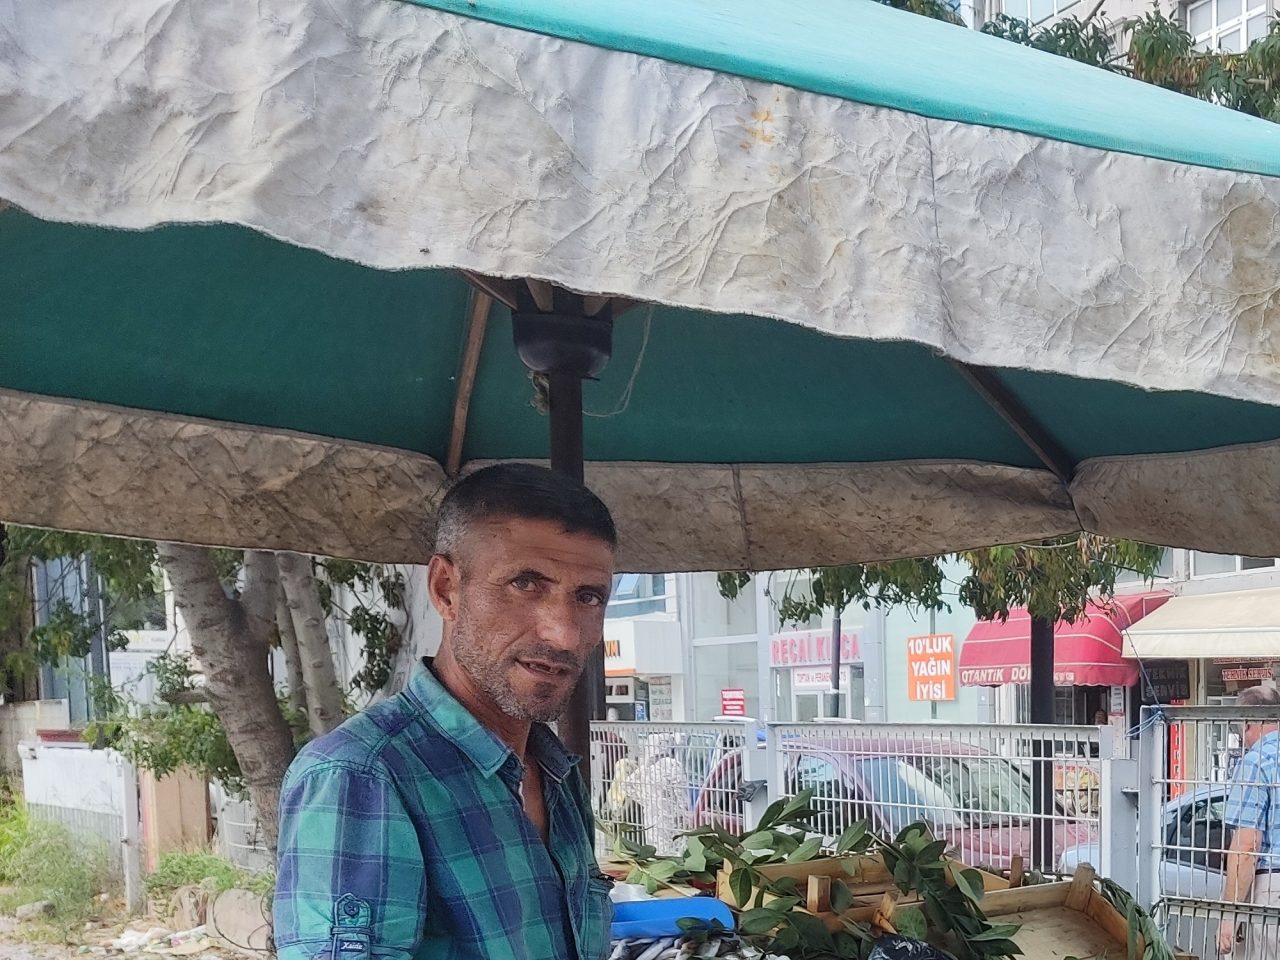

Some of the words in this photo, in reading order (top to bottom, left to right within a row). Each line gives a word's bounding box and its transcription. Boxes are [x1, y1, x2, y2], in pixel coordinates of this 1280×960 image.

[816, 633, 860, 662] KICA
[909, 636, 952, 655] 10'LUK
[911, 656, 951, 677] YAĞIN
[916, 680, 946, 700] İYİSİ
